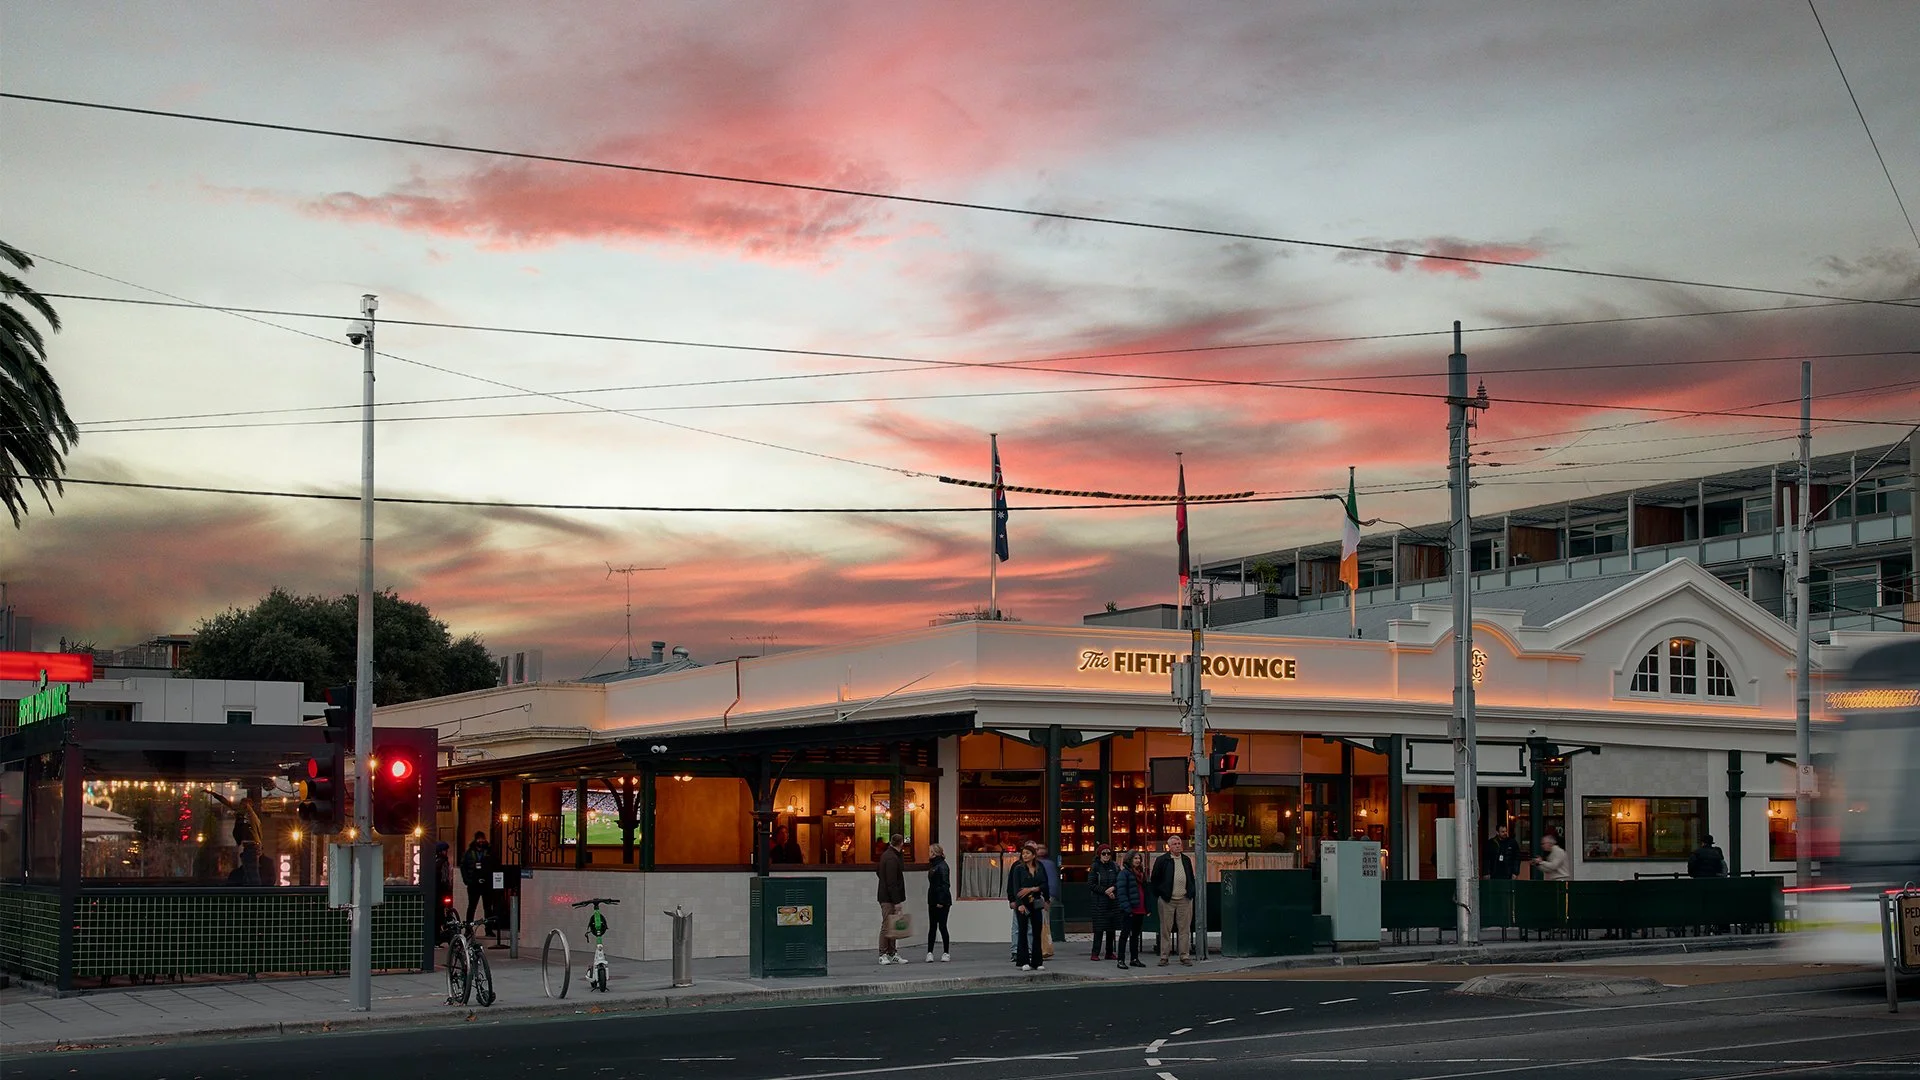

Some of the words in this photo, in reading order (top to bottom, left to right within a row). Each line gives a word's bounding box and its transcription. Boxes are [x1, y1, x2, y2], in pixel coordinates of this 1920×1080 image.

[1079, 650, 1110, 671] The
[1114, 652, 1176, 673] FIFTH
[1183, 655, 1296, 679] ROVINCE
[1206, 813, 1246, 828] FIFTH
[1188, 834, 1261, 848] POVINCE
[280, 855, 291, 887] LOLA
